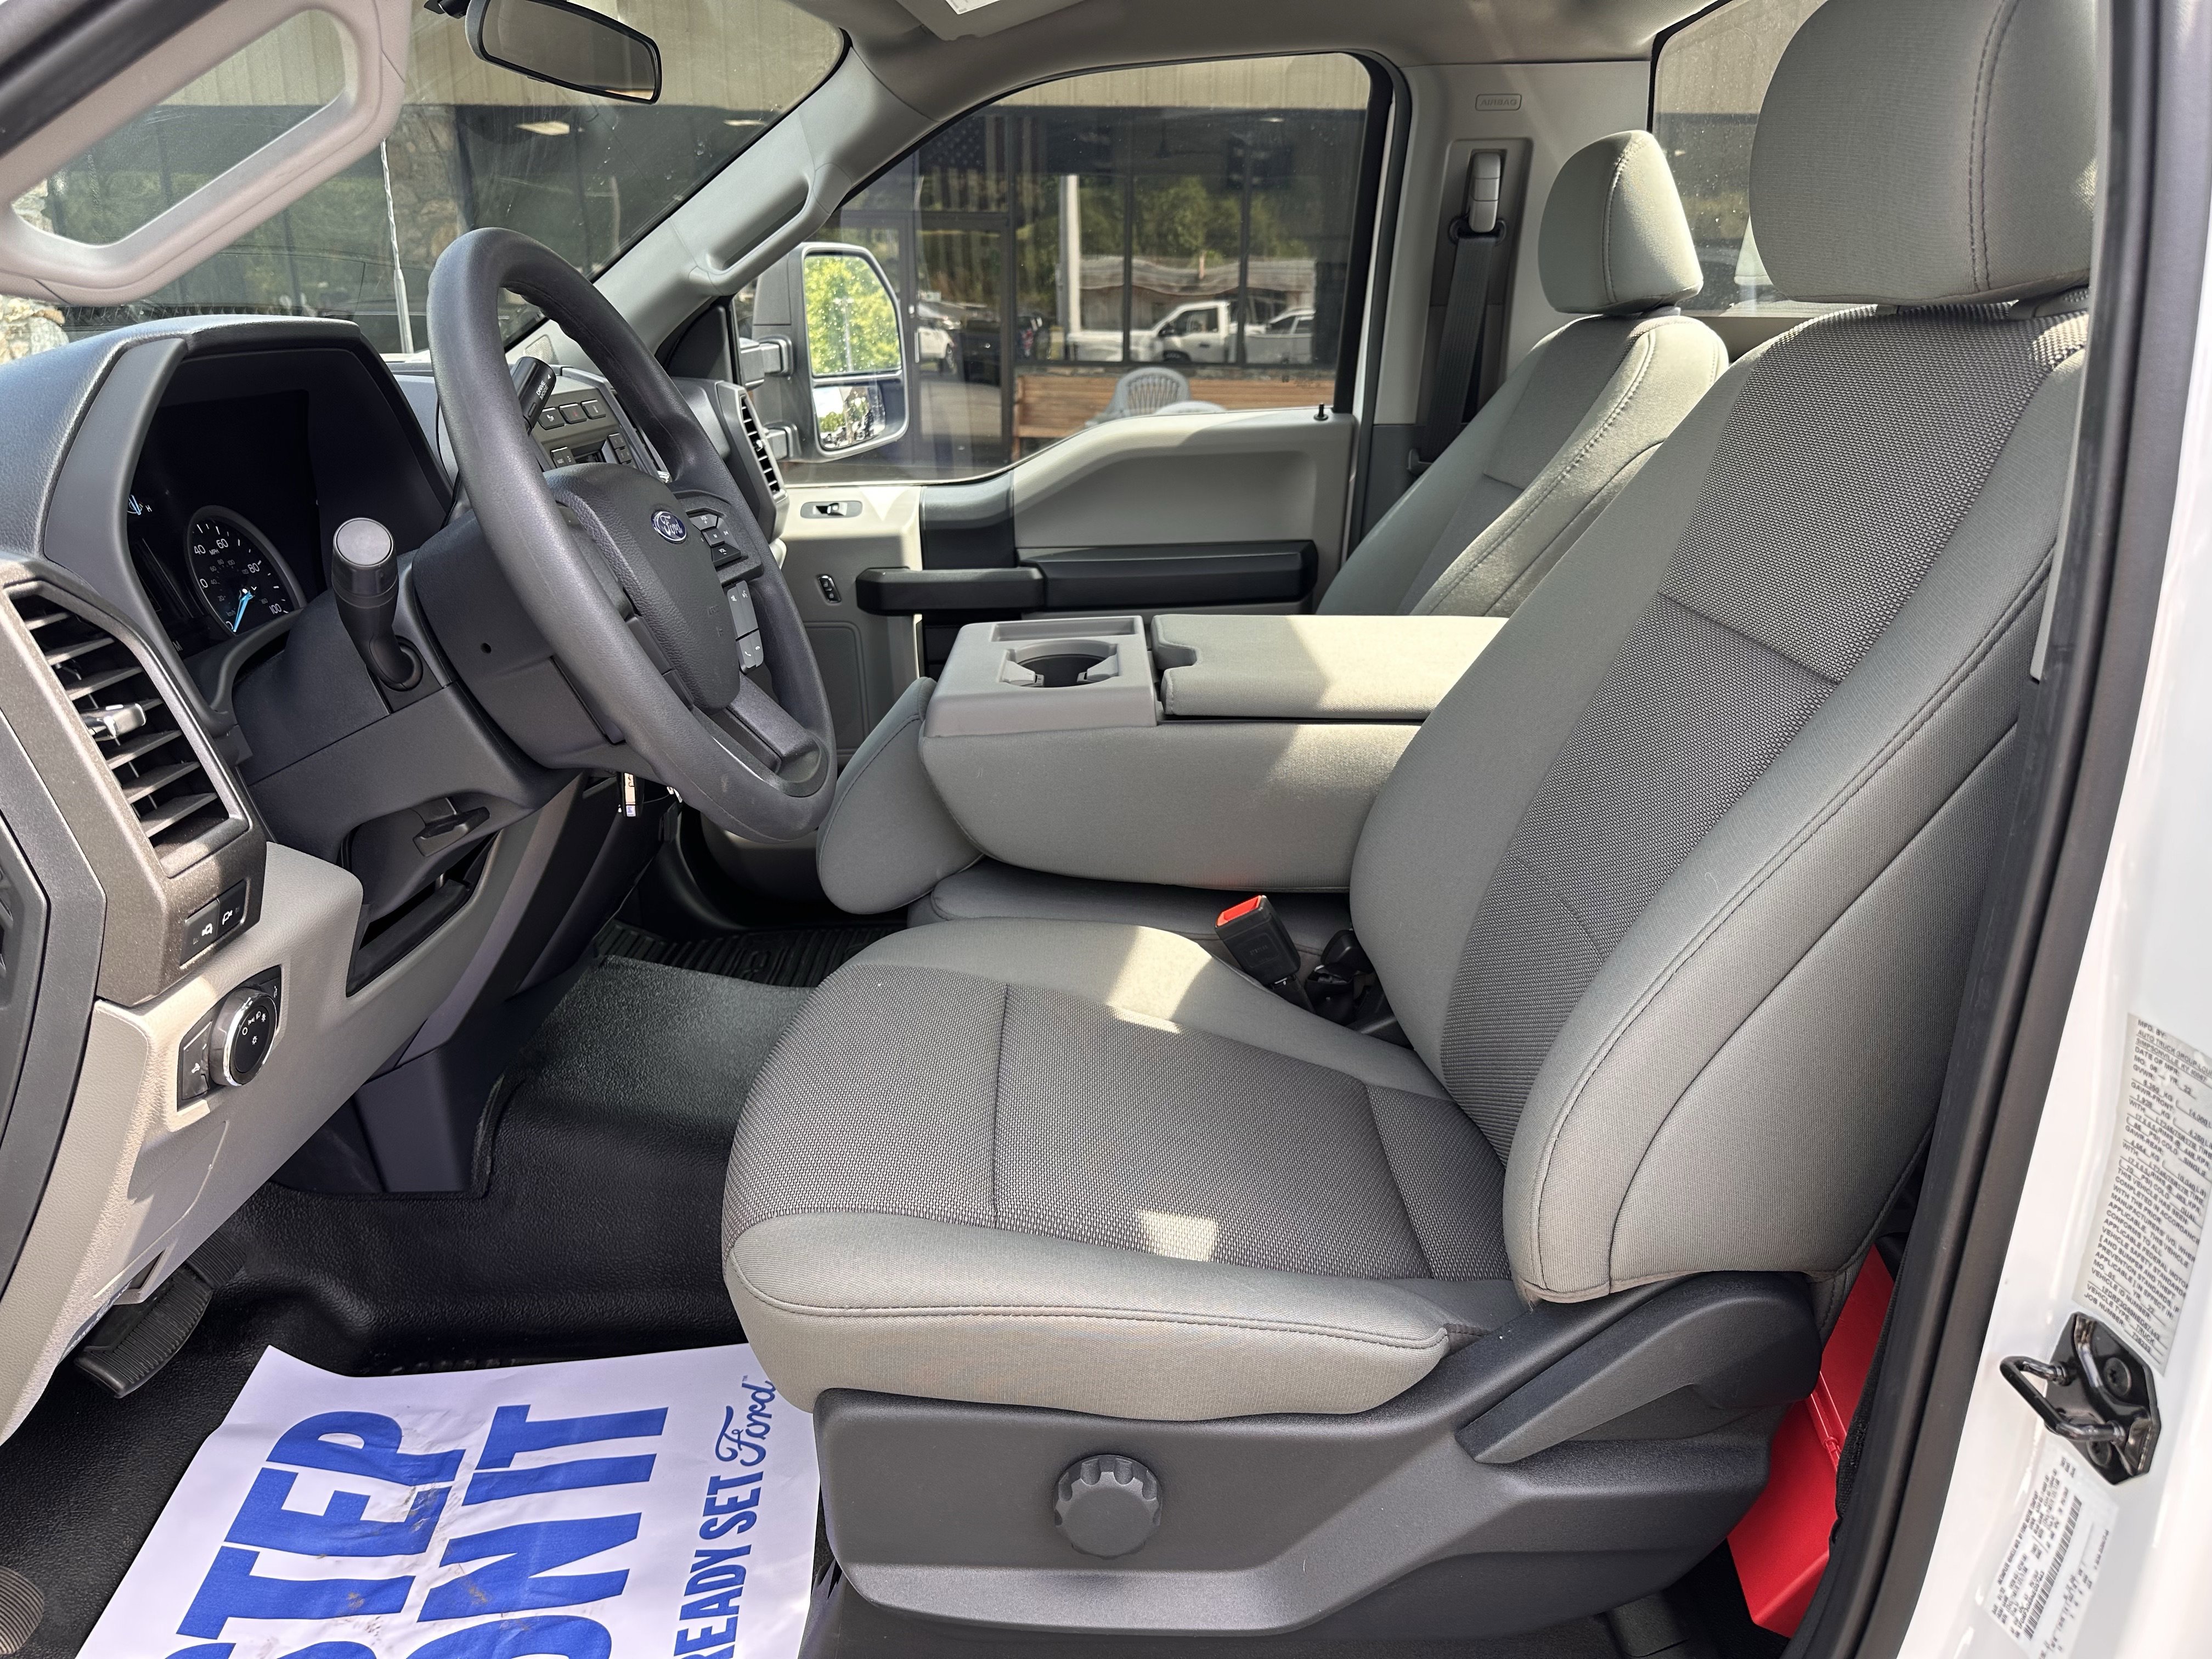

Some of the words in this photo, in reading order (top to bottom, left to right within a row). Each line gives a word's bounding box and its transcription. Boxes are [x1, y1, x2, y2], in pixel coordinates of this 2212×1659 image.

[536, 380, 546, 396] DRIVE
[540, 385, 549, 400] MODE
[145, 504, 153, 512] H
[660, 515, 683, 536] Ford
[194, 544, 206, 555] 40
[216, 538, 229, 549] 60
[247, 562, 260, 573] 80
[199, 578, 208, 588] 0
[269, 603, 283, 614] 100
[2135, 1046, 2153, 1060] DATE
[2137, 1030, 2154, 1042] AUTO
[2155, 1039, 2175, 1053] TRUCK
[2129, 1098, 2146, 1113] WITH
[2163, 1092, 2173, 1102] KG
[2161, 1109, 2170, 1120] KG
[2158, 1127, 2174, 1142] RIMS
[2123, 1142, 2138, 1156] WITH
[2151, 1151, 2159, 1162] KG
[2162, 1140, 2177, 1155] COLD
[2183, 1157, 2206, 1177] SINGLE
[2150, 1171, 2166, 1186] RIMS
[2113, 1184, 2130, 1199] WITH
[2131, 1196, 2143, 1210] THE
[2143, 1206, 2162, 1224] PRIOR
[2118, 1167, 2131, 1181] THIS
[2132, 1178, 2158, 1201] VEHICLE
[2158, 1198, 2171, 1211] HAS
[2171, 1208, 2188, 1224] BEEN
[2153, 1184, 2170, 1200] COLD
[2180, 1207, 2196, 1223] DUAL
[2115, 1176, 2152, 1206] COMPLETED
[2153, 1204, 2159, 1212] IN
[2160, 1210, 2200, 1245] ACCORDANCE
[2102, 1226, 2129, 1250] VEHICLE
[2129, 1246, 2152, 1268] SAFETY
[2103, 1218, 2141, 1250] APPLICABLE
[2142, 1246, 2168, 1273] FEDERAL
[2106, 1210, 2142, 1239] CONFORMS
[2142, 1235, 2151, 1246] TO
[2151, 1244, 2162, 1257] ALL
[2149, 1231, 2163, 1246] THIS
[2164, 1243, 2189, 1268] VEHICLE
[2091, 1267, 2118, 1292] VEHICLE
[2118, 1289, 2125, 1298] ID
[2095, 1251, 2133, 1283] APPLICABLE
[2136, 1283, 2143, 1291] IN
[2143, 1289, 2165, 1313] EFFECT
[2097, 1243, 2137, 1277] PREVENTION
[2173, 1305, 2180, 1313] IF
[2103, 1238, 2118, 1251] AND
[2118, 1248, 2143, 1272] BUMPER
[2143, 1268, 2157, 1283] AND
[2157, 1280, 2176, 1300] THEFT
[2084, 1292, 2098, 1305] JOB
[2087, 1283, 2114, 1308] VEHICLE
[2136, 1324, 2155, 1344] TRUCK
[715, 1380, 776, 1467] Ford
[461, 1404, 669, 1506] IT
[699, 1471, 764, 1540] SET
[164, 1410, 466, 1659] TEP
[674, 1544, 752, 1659] EADY
